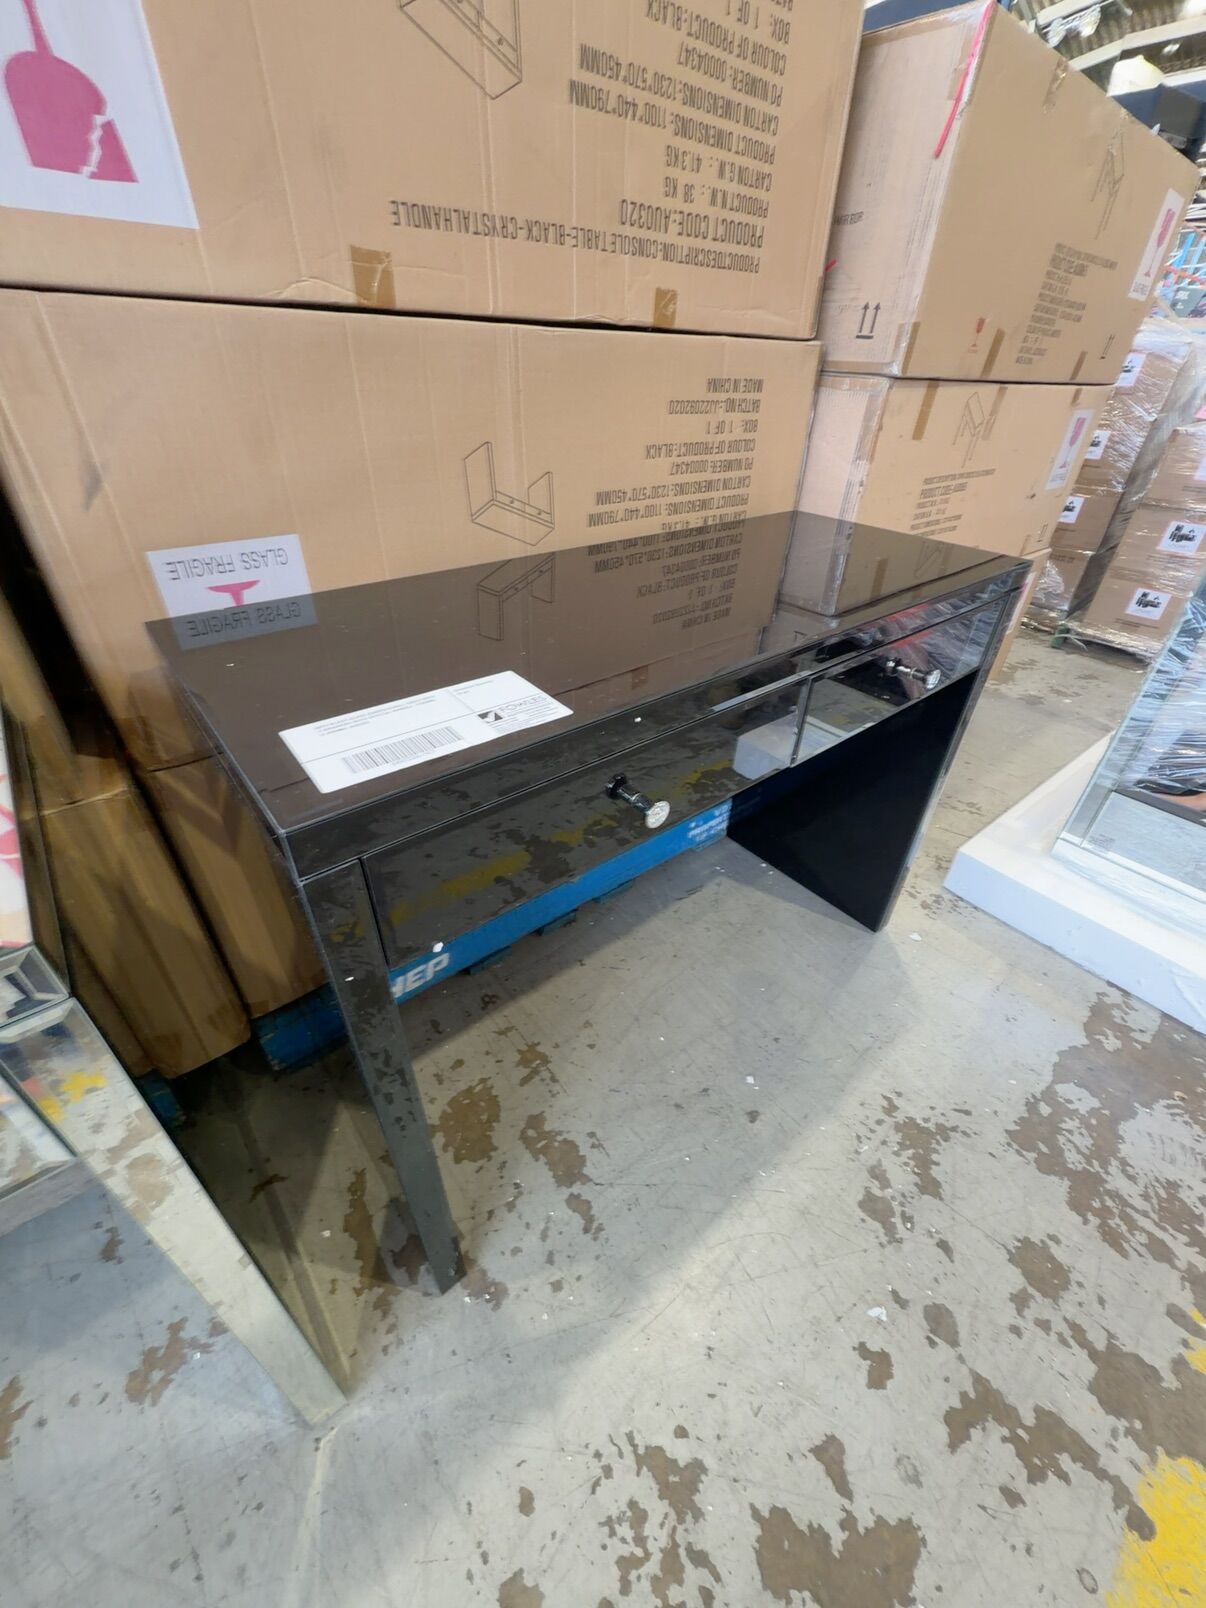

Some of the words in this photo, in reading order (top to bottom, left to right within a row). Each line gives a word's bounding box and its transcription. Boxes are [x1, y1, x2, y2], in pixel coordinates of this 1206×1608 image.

[736, 0, 750, 26] OF
[753, 7, 759, 30] 1
[769, 14, 791, 45] BOX:
[736, 34, 749, 61] OF
[677, 41, 728, 82] 00004347
[751, 43, 787, 76] COLOUR
[728, 65, 770, 103] NUMBER:
[771, 83, 784, 107] PO
[743, 105, 779, 136] CARTON
[670, 112, 734, 152] DIMENSIONS:
[734, 133, 776, 165] PRODUCT
[663, 176, 678, 199] KG
[737, 165, 773, 192] CARTON
[683, 183, 696, 204] 38
[729, 191, 770, 219] PRODUCT
[711, 216, 764, 249] PRODUCT
[706, 377, 732, 393] CHINA
[732, 378, 742, 394] IN
[742, 378, 764, 394] MADE
[737, 398, 761, 413] BATCH
[705, 421, 711, 435] 1
[714, 420, 726, 435] OF
[729, 420, 734, 433] 1
[741, 419, 759, 433] BOX:
[714, 440, 726, 455] OF
[727, 438, 756, 454] COLOUR
[669, 459, 709, 476] 00004347
[710, 458, 744, 474] NUMBER:
[744, 457, 754, 470] PO
[722, 475, 751, 491] CARTON
[665, 497, 715, 517] DIMENSIONS:
[715, 493, 749, 509] PRODUCT
[165, 553, 236, 581] FRAGILE
[240, 547, 289, 570] GLASS
